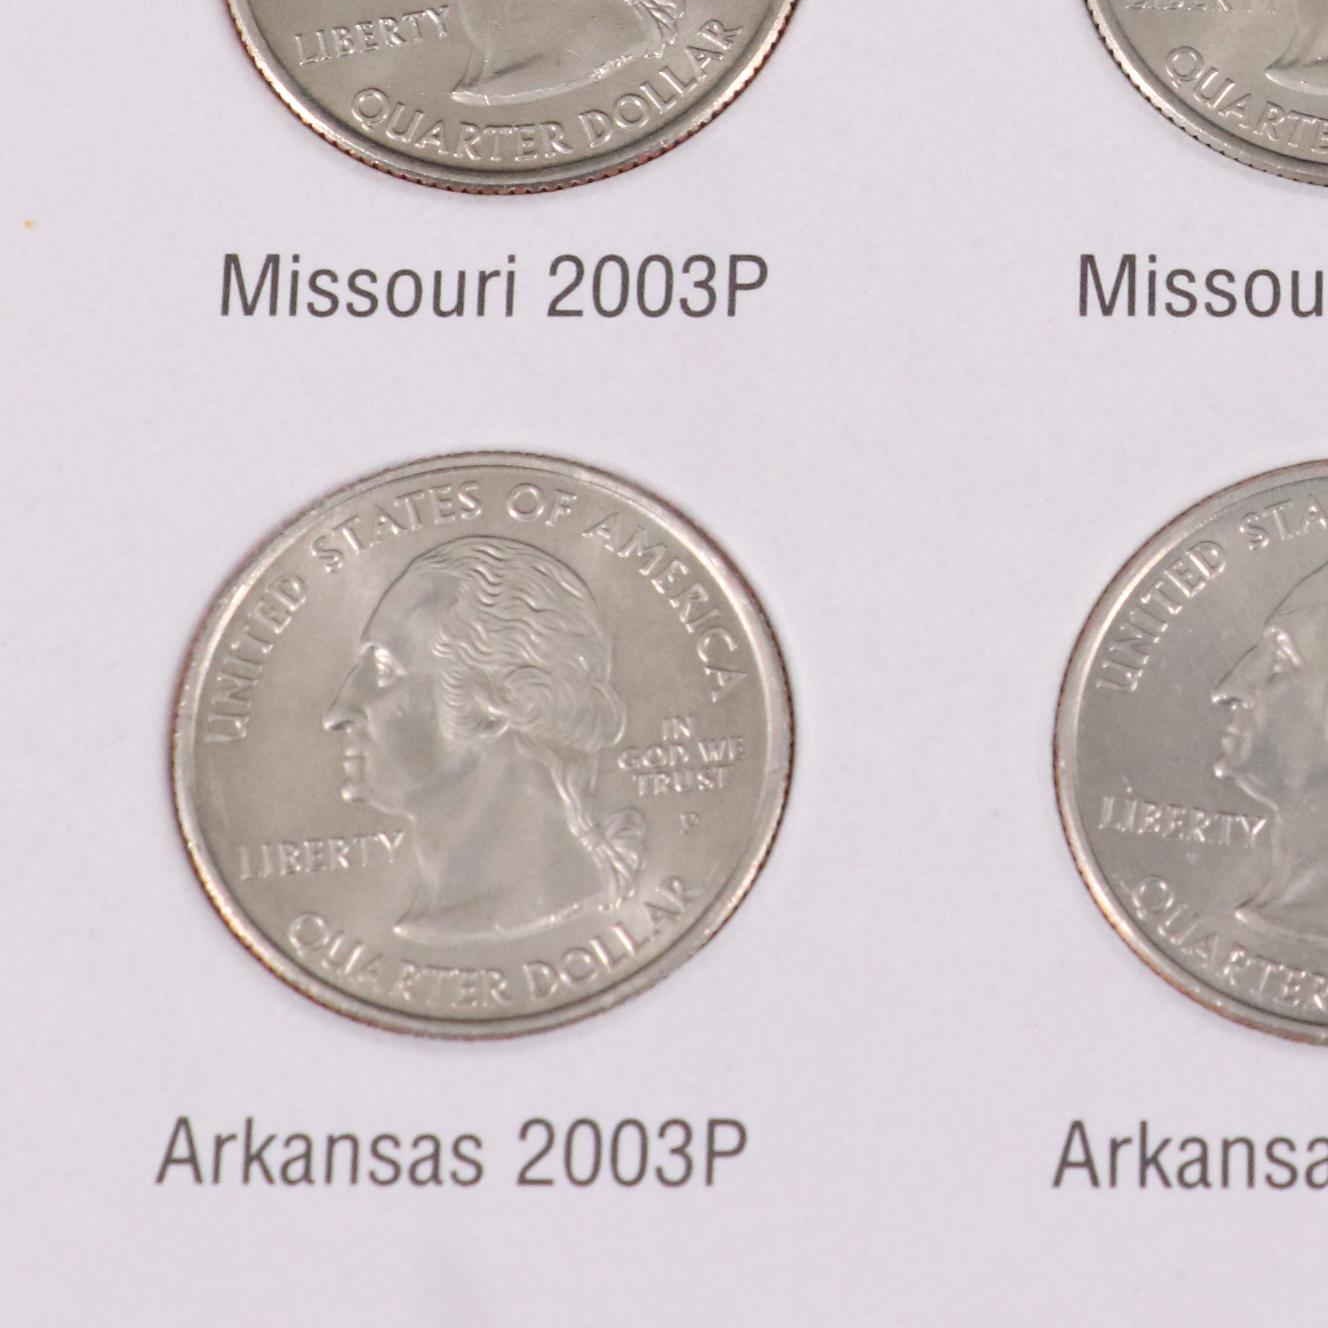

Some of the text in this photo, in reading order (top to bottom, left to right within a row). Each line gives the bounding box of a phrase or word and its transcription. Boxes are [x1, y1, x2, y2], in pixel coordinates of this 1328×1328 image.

[295, 5, 451, 65] LIBERTY
[350, 18, 743, 162] QUARTER DOLLAR
[221, 253, 769, 318] Missouri 2003P
[206, 481, 747, 744] UNITED STATES OF AMERICA
[1096, 540, 1226, 694] UNITED
[617, 737, 745, 771] GOD WE
[661, 716, 692, 739] IN
[631, 767, 733, 797] TRUST
[1100, 797, 1267, 849] LIBERTY
[238, 831, 405, 881] LIBERTY
[288, 877, 700, 1008] QUARTER DOLLAR
[156, 1116, 748, 1187] Arkansas 2003P
